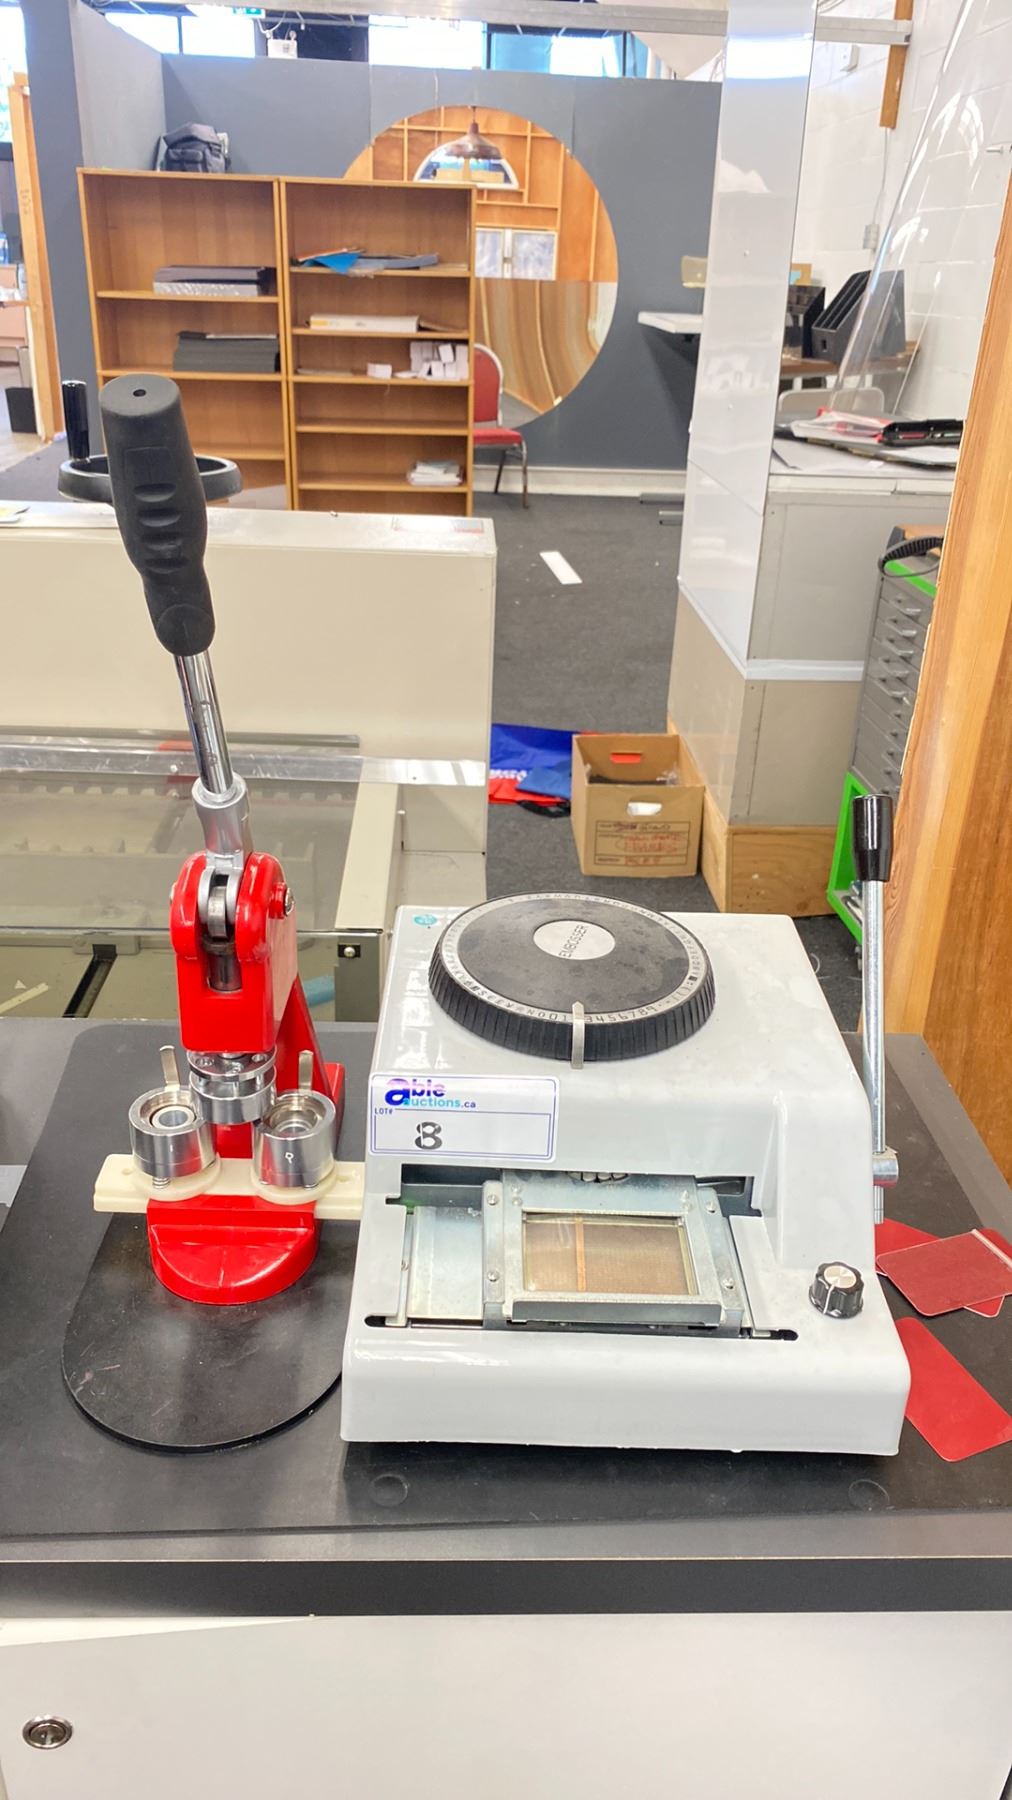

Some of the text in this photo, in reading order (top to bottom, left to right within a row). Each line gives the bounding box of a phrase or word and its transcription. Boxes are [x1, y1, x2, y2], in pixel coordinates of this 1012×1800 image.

[559, 924, 588, 958] EMBOSSER
[374, 1107, 393, 1115] LOT#
[414, 1121, 442, 1150] 8
